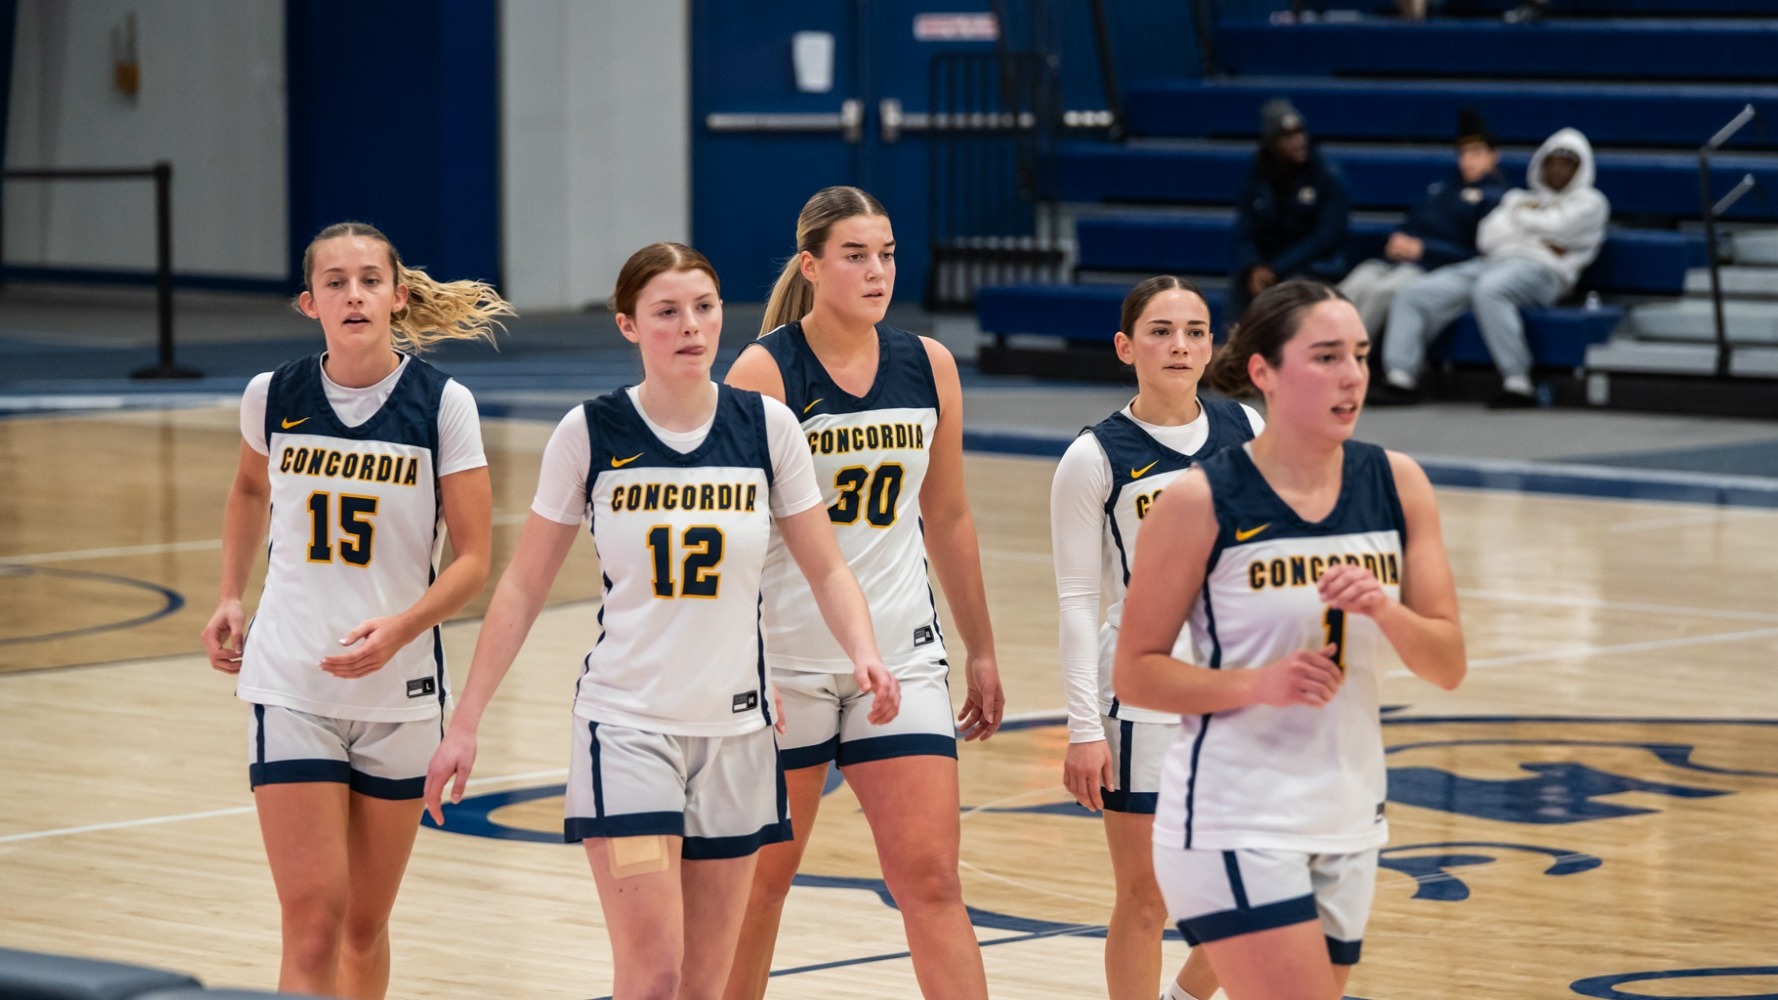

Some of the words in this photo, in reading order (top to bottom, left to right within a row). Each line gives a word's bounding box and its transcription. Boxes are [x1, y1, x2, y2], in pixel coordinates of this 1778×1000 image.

[279, 446, 419, 486] CONCORDIA
[807, 423, 924, 455] CONCORDIA
[306, 489, 379, 568] 15
[611, 482, 757, 513] CONCORDIA
[827, 461, 905, 529] 30
[645, 524, 726, 599] 12
[1322, 606, 1346, 676] 1
